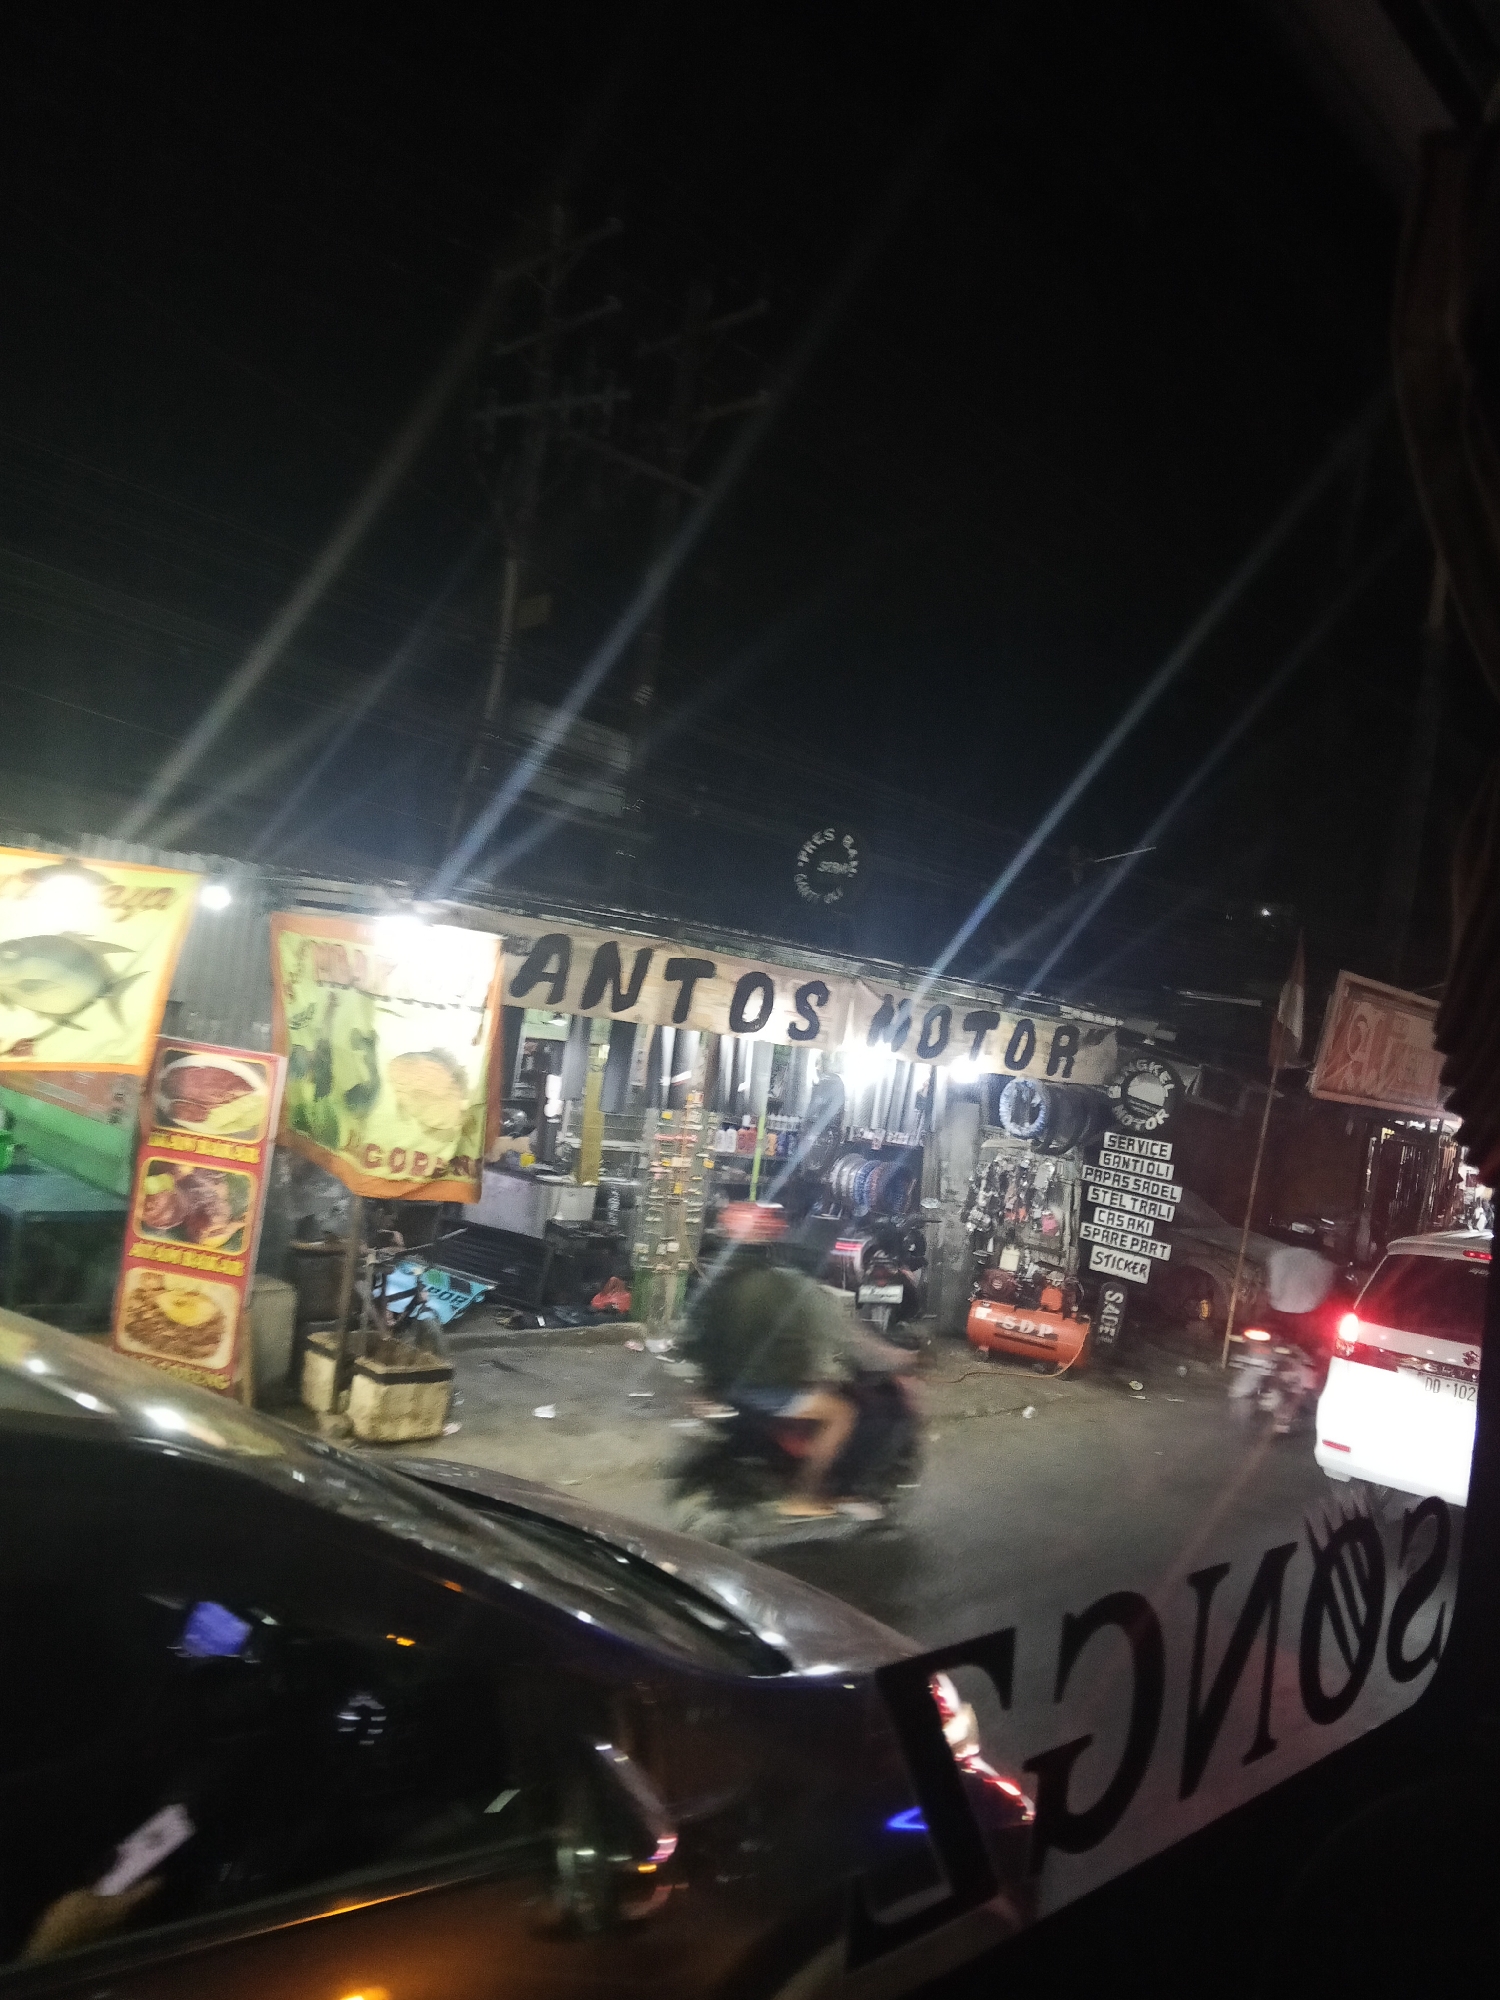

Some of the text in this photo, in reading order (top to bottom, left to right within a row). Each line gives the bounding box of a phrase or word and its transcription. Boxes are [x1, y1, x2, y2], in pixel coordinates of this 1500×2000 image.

[509, 933, 830, 1042] ANTOS
[866, 993, 1081, 1079] MOTOR
[1112, 1104, 1170, 1131] MOTOR
[1107, 1134, 1168, 1157] SERVICE
[1090, 1187, 1172, 1220] STEL TRALI
[1083, 1225, 1168, 1258] SPARE PART
[1092, 1251, 1148, 1279] STICKER
